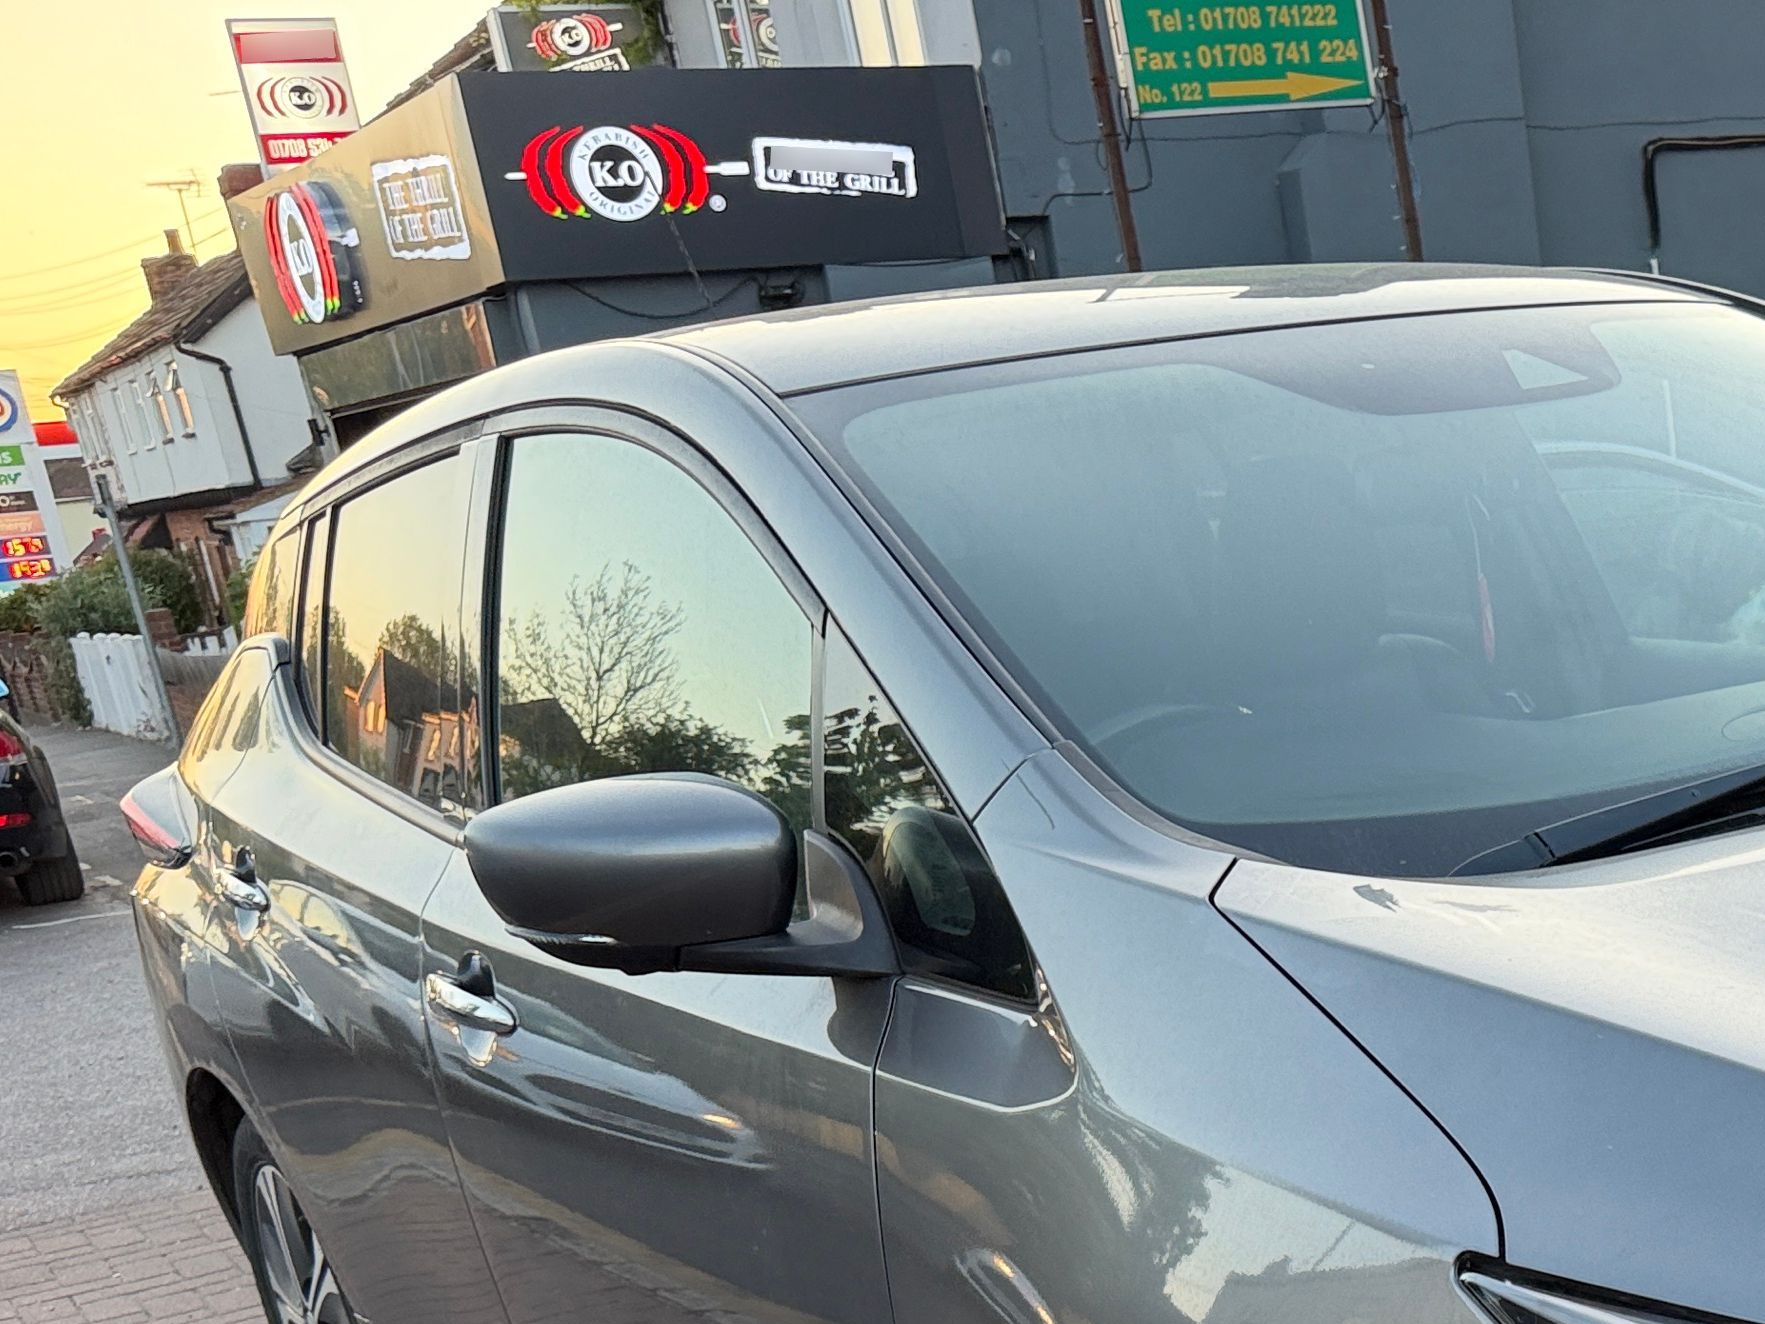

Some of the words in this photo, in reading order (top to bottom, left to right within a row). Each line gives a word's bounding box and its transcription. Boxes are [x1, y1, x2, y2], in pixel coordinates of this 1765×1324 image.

[1148, 9, 1181, 32] Tel
[1200, 6, 1261, 30] 01708
[1134, 47, 1177, 70] Fax
[1197, 43, 1266, 68] 01708
[1272, 41, 1311, 65] 741
[1319, 39, 1358, 63] 224
[1138, 84, 1167, 104] No.
[1171, 82, 1203, 102] 122
[589, 159, 645, 188] K.O
[795, 170, 840, 188] THE
[843, 172, 906, 196] GRILL
[382, 181, 410, 210] THE
[389, 215, 405, 243] OF
[401, 212, 429, 242] THE
[426, 206, 462, 240] GRILL
